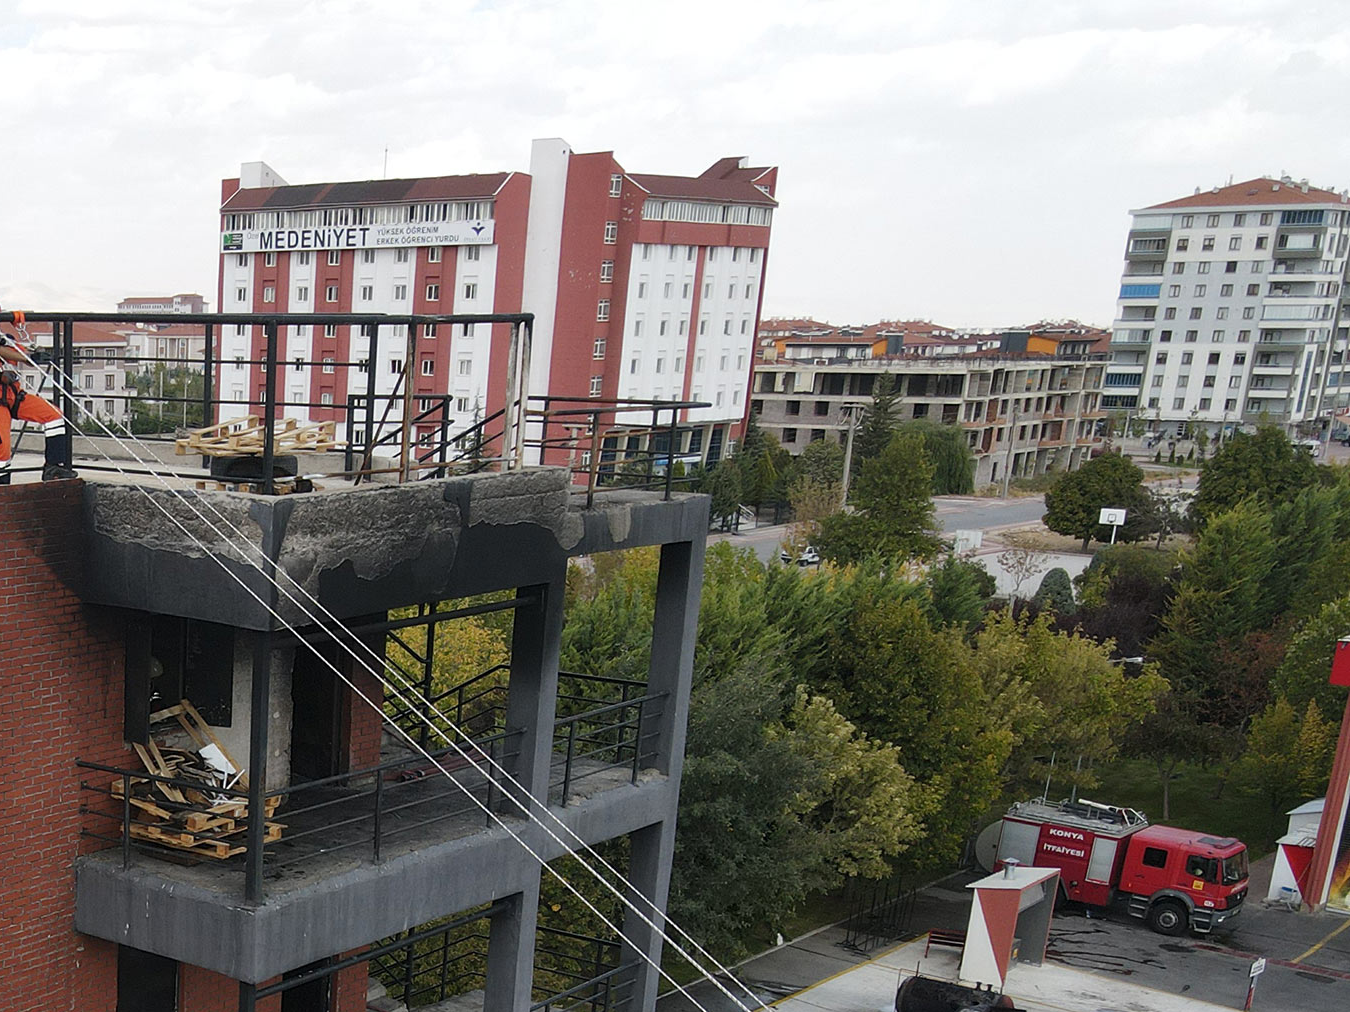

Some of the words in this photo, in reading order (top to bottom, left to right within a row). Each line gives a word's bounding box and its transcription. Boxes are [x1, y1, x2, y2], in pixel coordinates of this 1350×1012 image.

[377, 227, 405, 236] YÜKSEK
[376, 237, 400, 245] ERKEK
[434, 235, 460, 243] YURDU
[1049, 828, 1084, 841] KONYA
